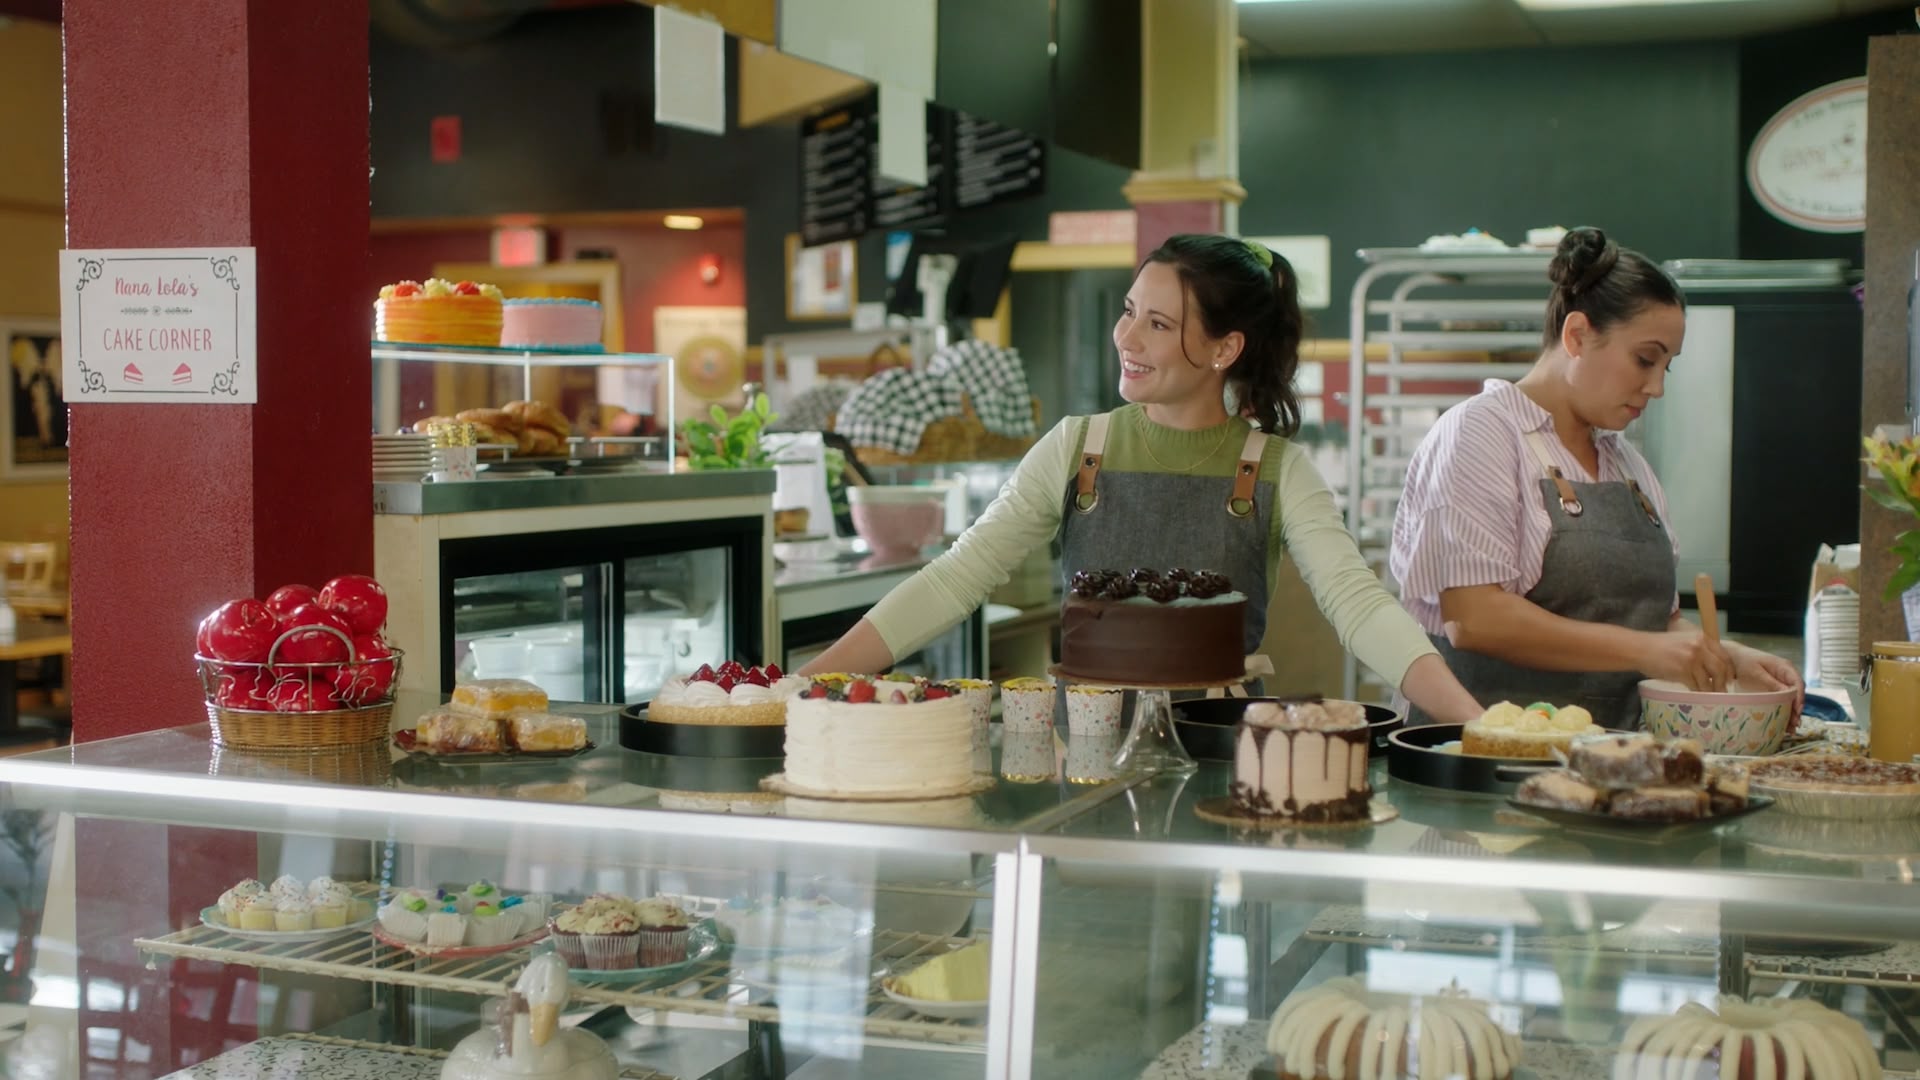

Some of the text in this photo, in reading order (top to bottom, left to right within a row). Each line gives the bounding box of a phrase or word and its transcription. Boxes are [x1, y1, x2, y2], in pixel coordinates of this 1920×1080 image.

[115, 274, 199, 298] Nana Lola's
[103, 328, 213, 351] CAKE CORNER
